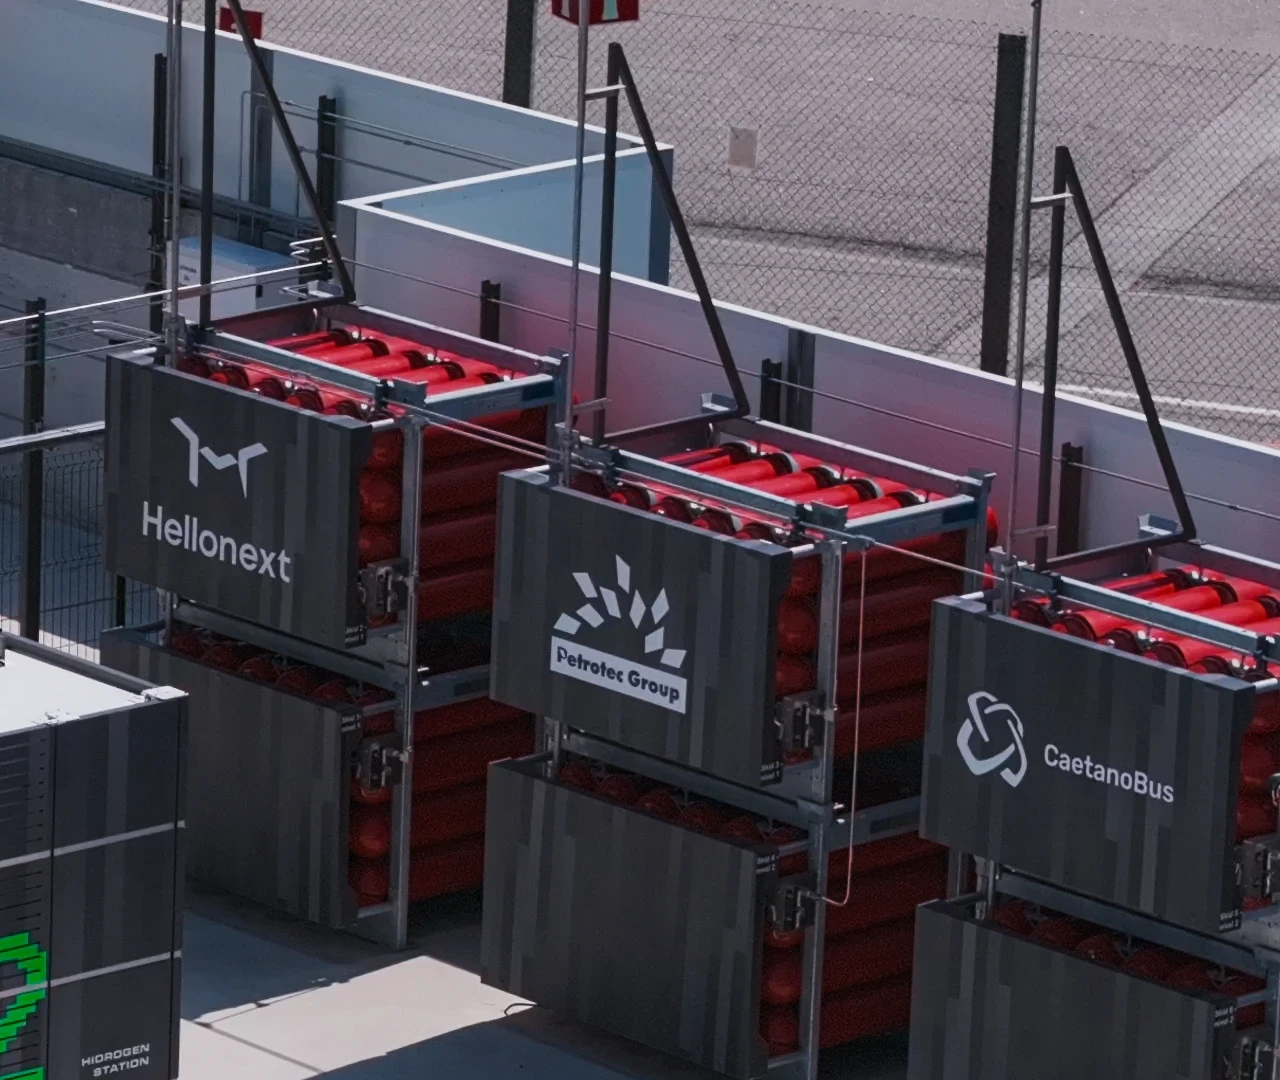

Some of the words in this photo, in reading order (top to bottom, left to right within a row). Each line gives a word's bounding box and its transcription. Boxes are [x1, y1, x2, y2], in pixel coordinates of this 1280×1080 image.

[142, 501, 291, 583] Hellonext
[557, 646, 624, 684] Petrotec
[627, 670, 680, 704] Group
[1044, 744, 1174, 803] CaetanoBus
[81, 1043, 150, 1067] HIDROGEN
[93, 1055, 149, 1077] STATION
